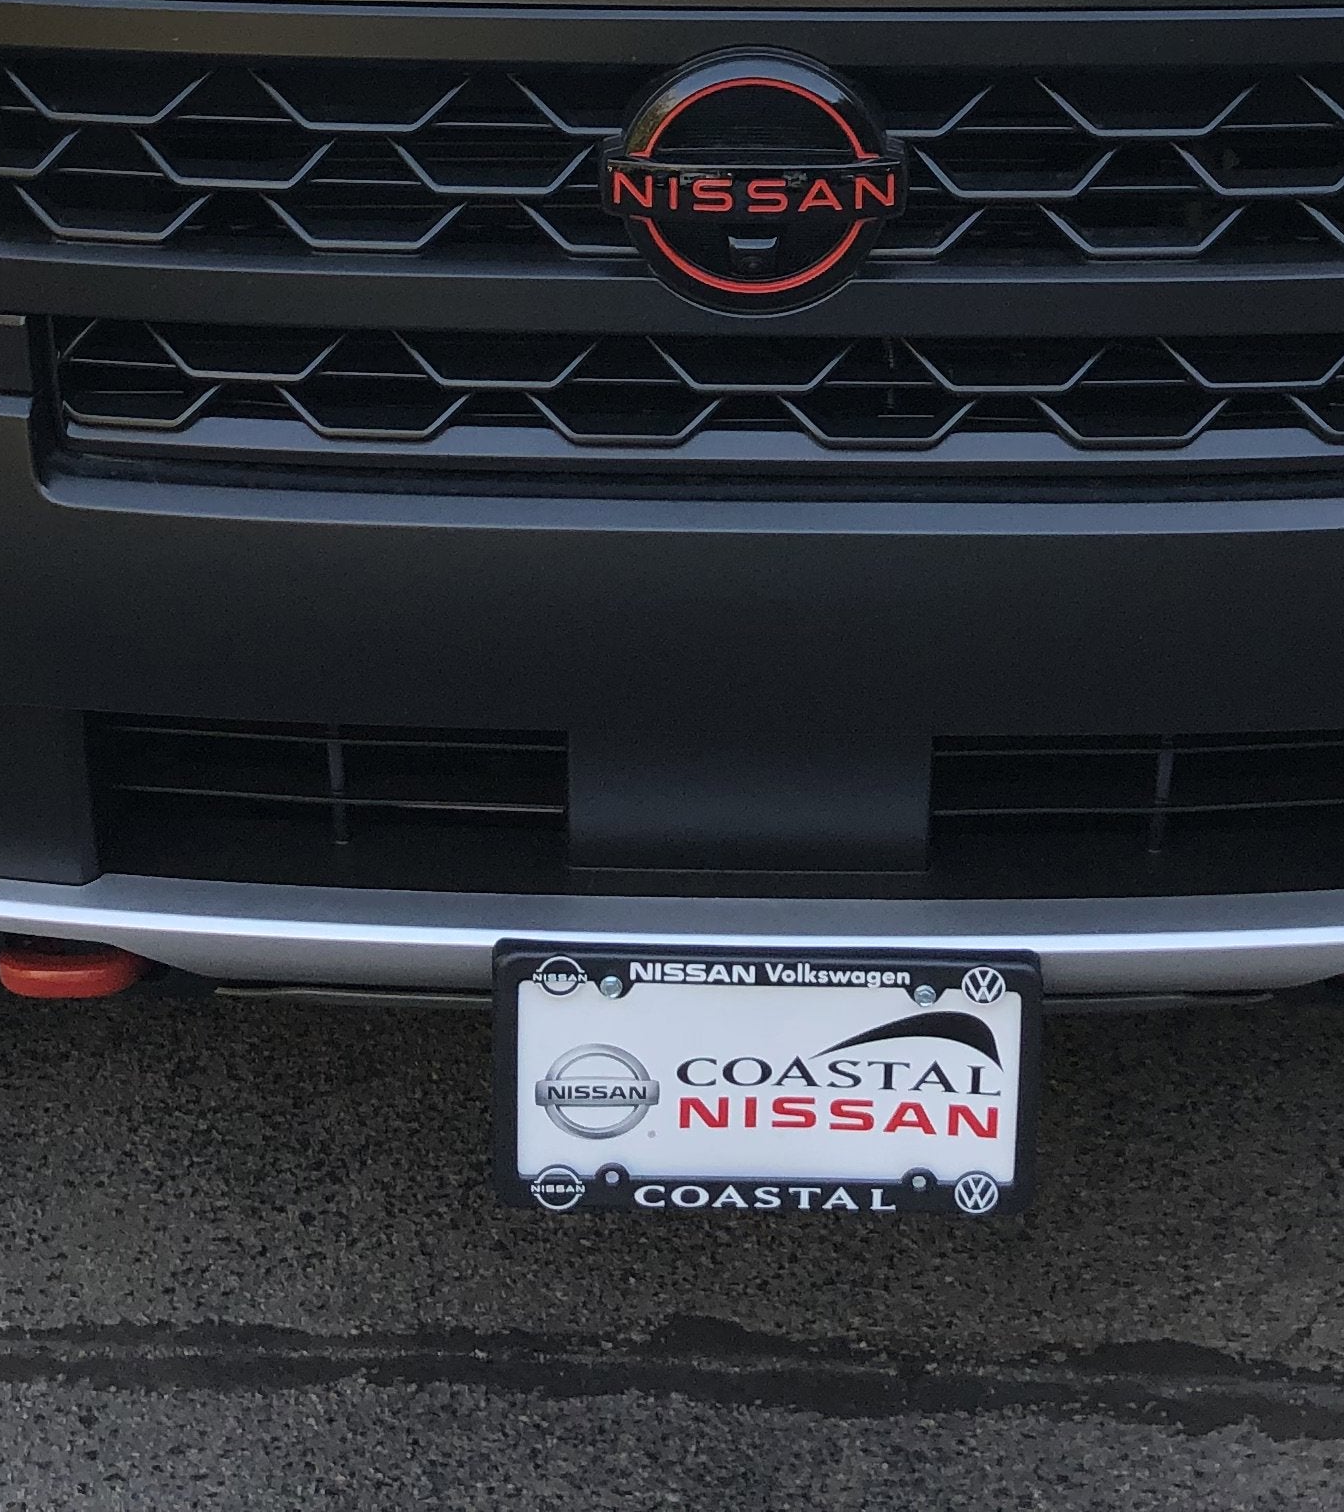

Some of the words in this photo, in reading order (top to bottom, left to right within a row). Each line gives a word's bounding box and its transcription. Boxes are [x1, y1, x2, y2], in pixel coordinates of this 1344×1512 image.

[612, 171, 895, 212] NISSAN
[533, 970, 588, 983] NISSAN
[629, 962, 756, 984] NISSAN
[765, 963, 911, 986] Volkswagen
[676, 1055, 1002, 1096] COASTAL
[547, 1084, 647, 1100] NISSAN
[679, 1096, 999, 1138] NISSAN
[530, 1183, 586, 1195] NISSAN
[634, 1185, 897, 1211] COASTAL
